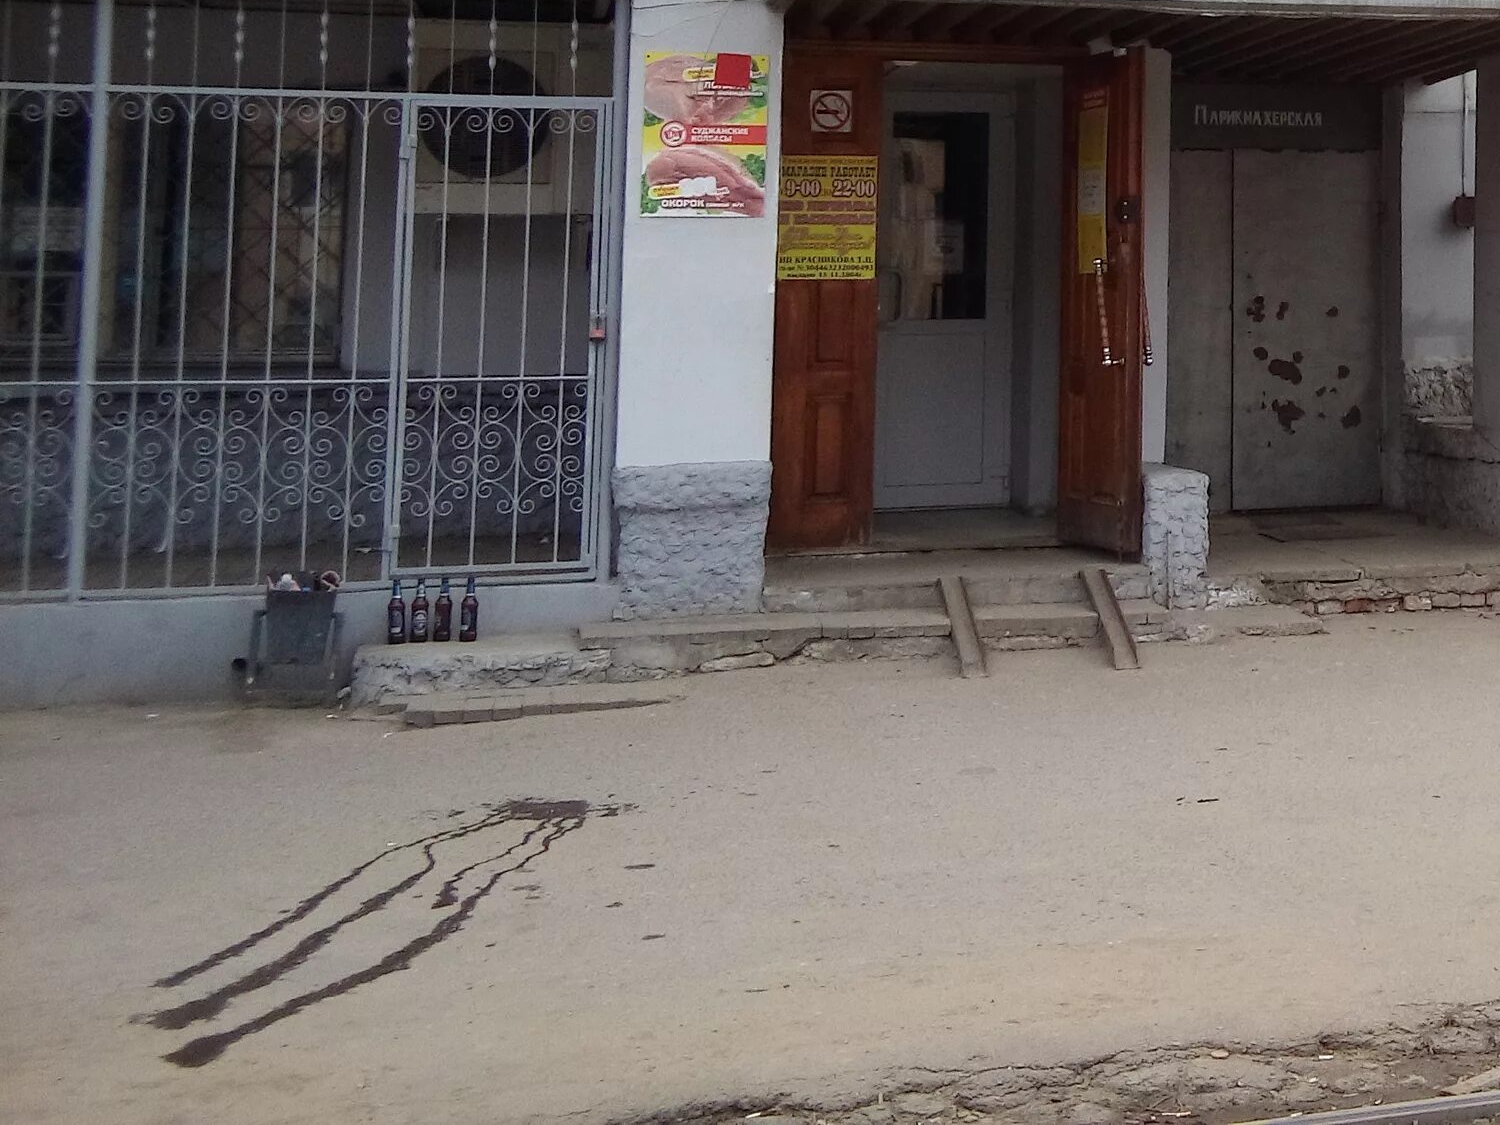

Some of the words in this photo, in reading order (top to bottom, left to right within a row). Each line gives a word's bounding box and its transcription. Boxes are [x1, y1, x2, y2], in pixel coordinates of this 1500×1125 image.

[785, 179, 821, 198] 9-00
[831, 179, 876, 198] 22-00
[661, 199, 705, 208] ОКОРОК
